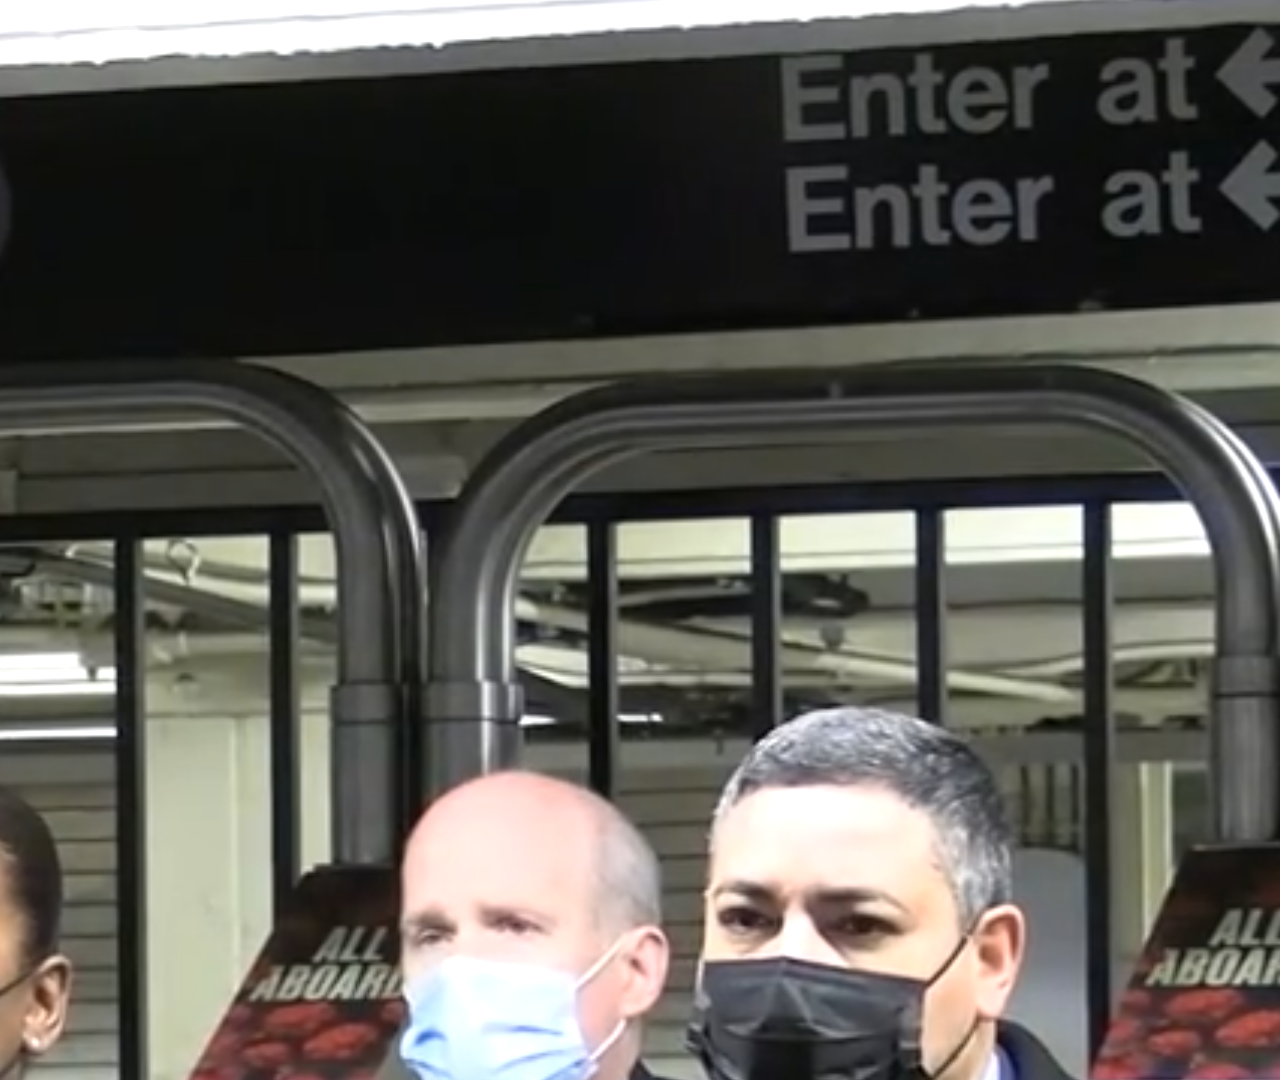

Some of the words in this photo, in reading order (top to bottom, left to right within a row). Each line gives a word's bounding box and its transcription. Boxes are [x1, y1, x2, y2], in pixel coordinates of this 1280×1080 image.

[781, 53, 1050, 142] Enter
[1096, 38, 1199, 126] at
[784, 163, 1055, 254] Enter
[1101, 151, 1202, 238] at
[311, 926, 388, 964] ALL
